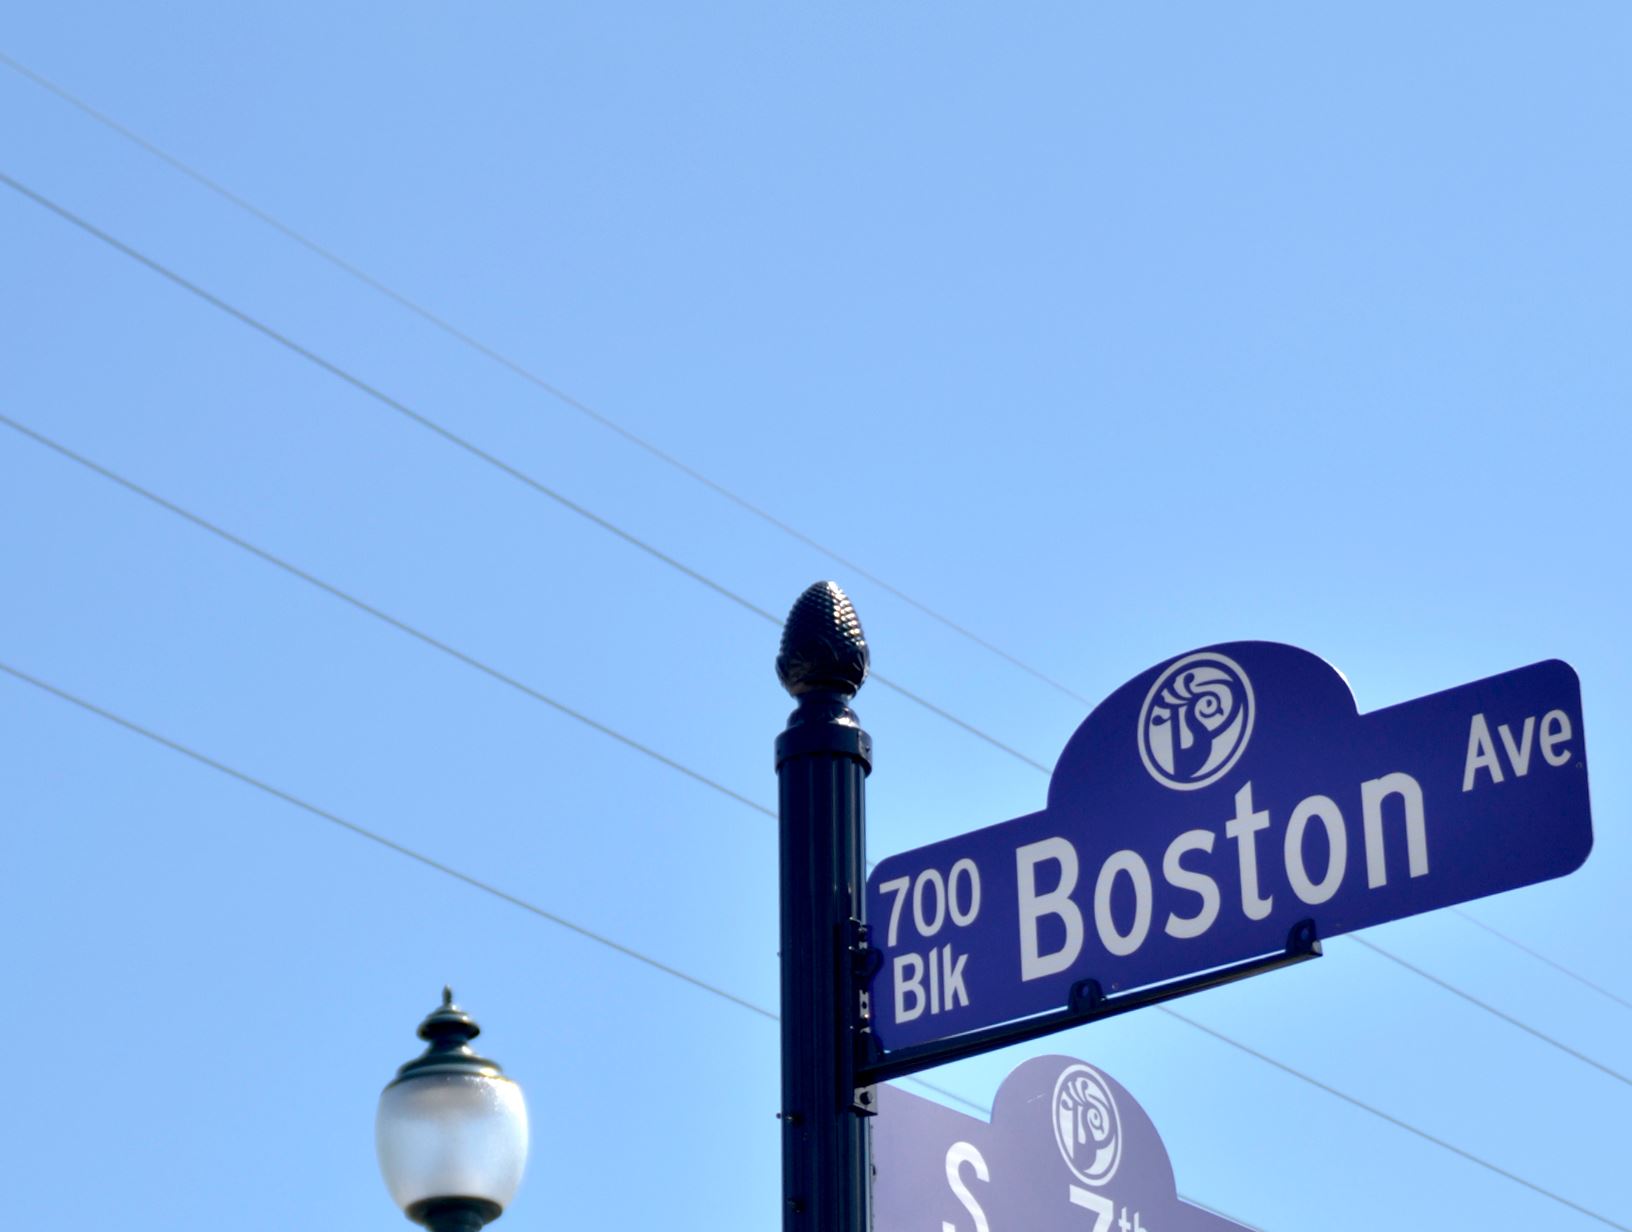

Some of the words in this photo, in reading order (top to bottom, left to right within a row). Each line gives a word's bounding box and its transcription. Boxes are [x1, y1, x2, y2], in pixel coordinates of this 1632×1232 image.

[1016, 771, 1429, 982] Boston
[1462, 708, 1573, 792] Ave
[880, 859, 981, 947] 700
[893, 945, 970, 1024] Blk
